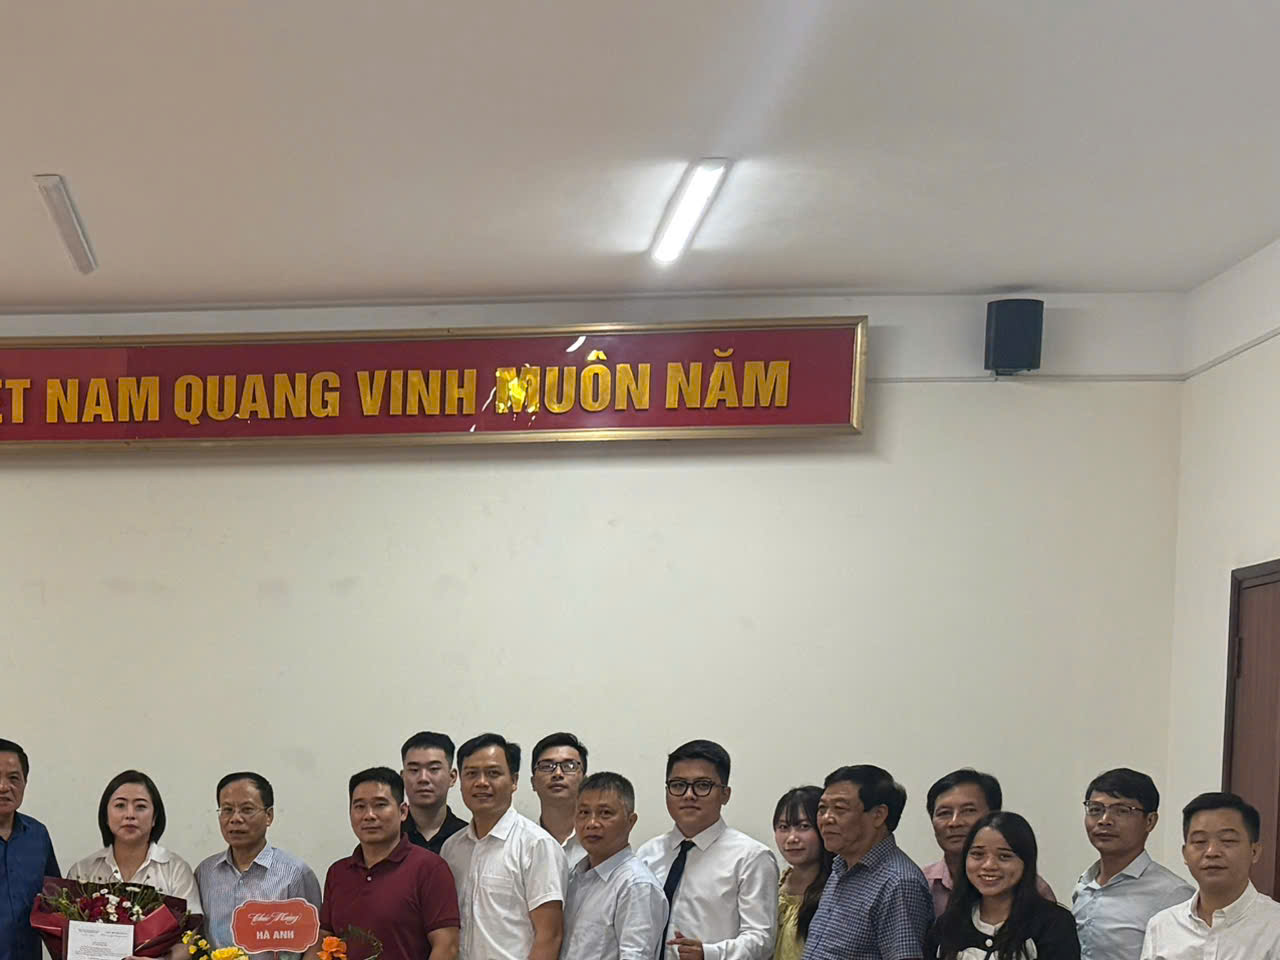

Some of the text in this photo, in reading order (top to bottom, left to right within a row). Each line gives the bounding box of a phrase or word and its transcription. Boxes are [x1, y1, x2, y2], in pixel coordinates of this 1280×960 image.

[46, 376, 160, 423] NAM
[173, 371, 341, 425] QUANG
[356, 369, 478, 416] VINH
[494, 350, 651, 414] MUÔN
[665, 348, 790, 409] NĂM
[273, 929, 295, 940] ANH
